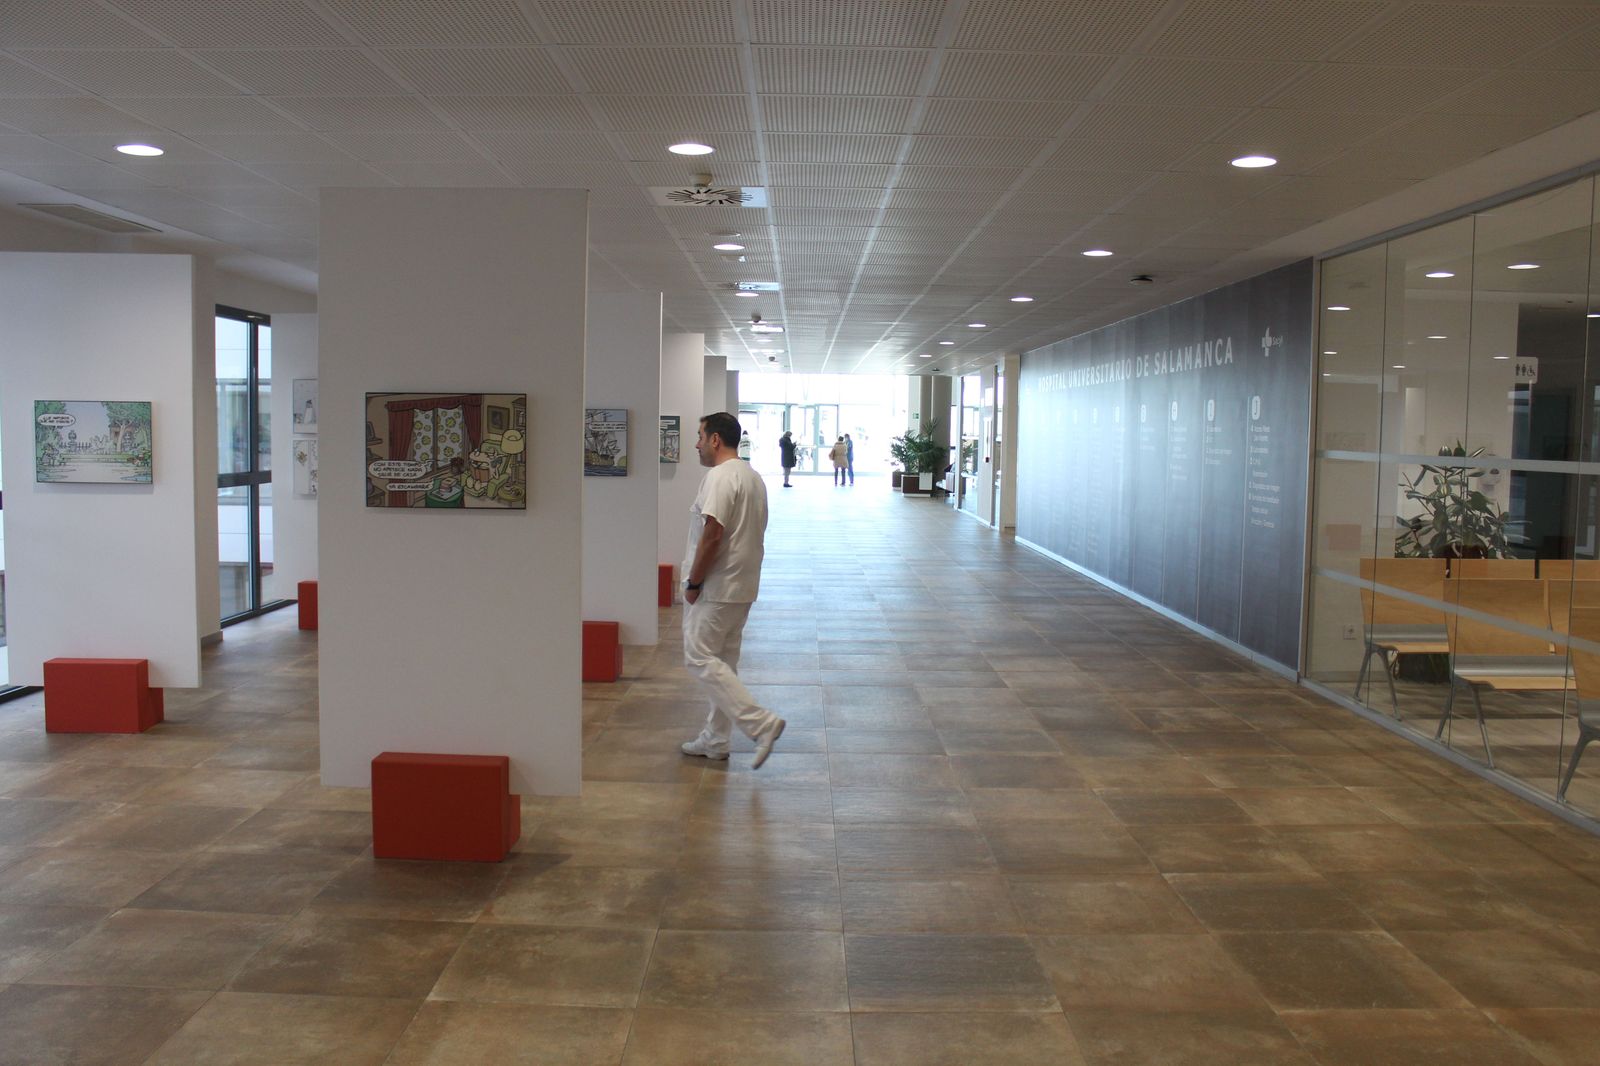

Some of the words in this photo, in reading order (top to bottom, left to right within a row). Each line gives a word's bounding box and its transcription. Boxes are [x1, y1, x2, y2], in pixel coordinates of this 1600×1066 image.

[1038, 374, 1066, 393] HOSPITAL
[1068, 358, 1132, 390] UNIVERSITARIO
[1136, 355, 1149, 378] DE
[1153, 336, 1234, 376] SALAMANCA
